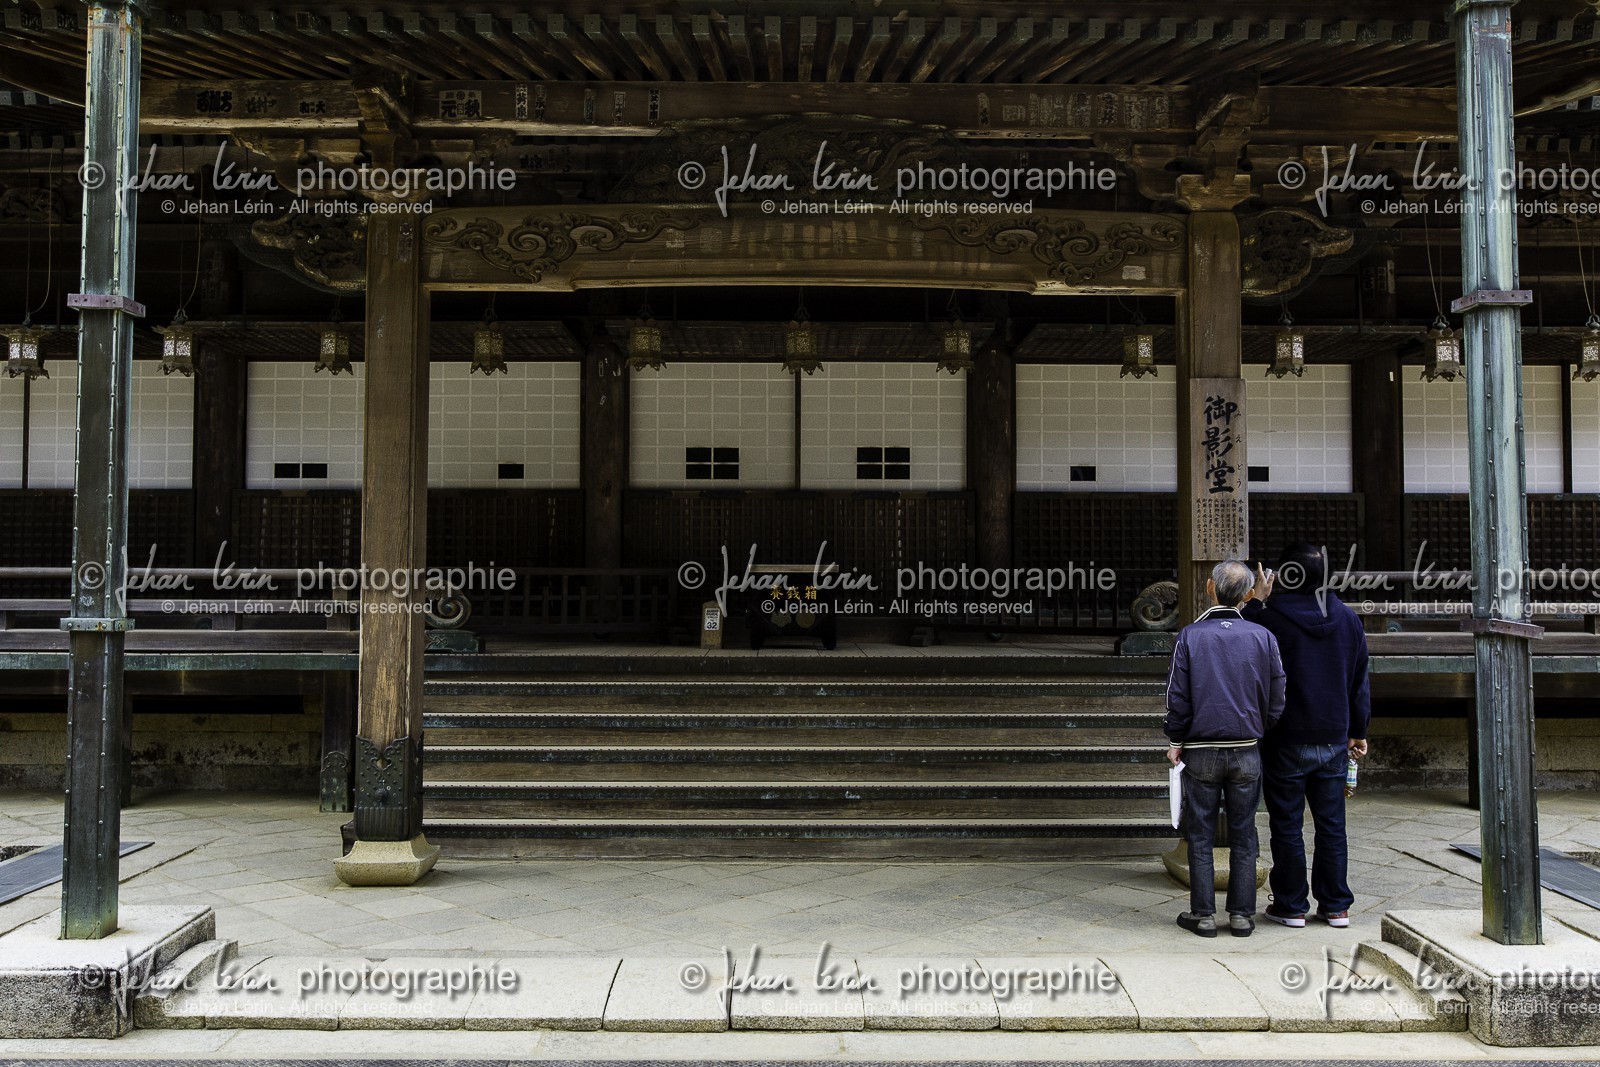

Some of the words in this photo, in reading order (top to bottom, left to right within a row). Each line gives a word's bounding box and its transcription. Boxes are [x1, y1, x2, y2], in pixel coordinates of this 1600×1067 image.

[1201, 395, 1236, 494] 御影堂
[706, 621, 718, 630] 32
